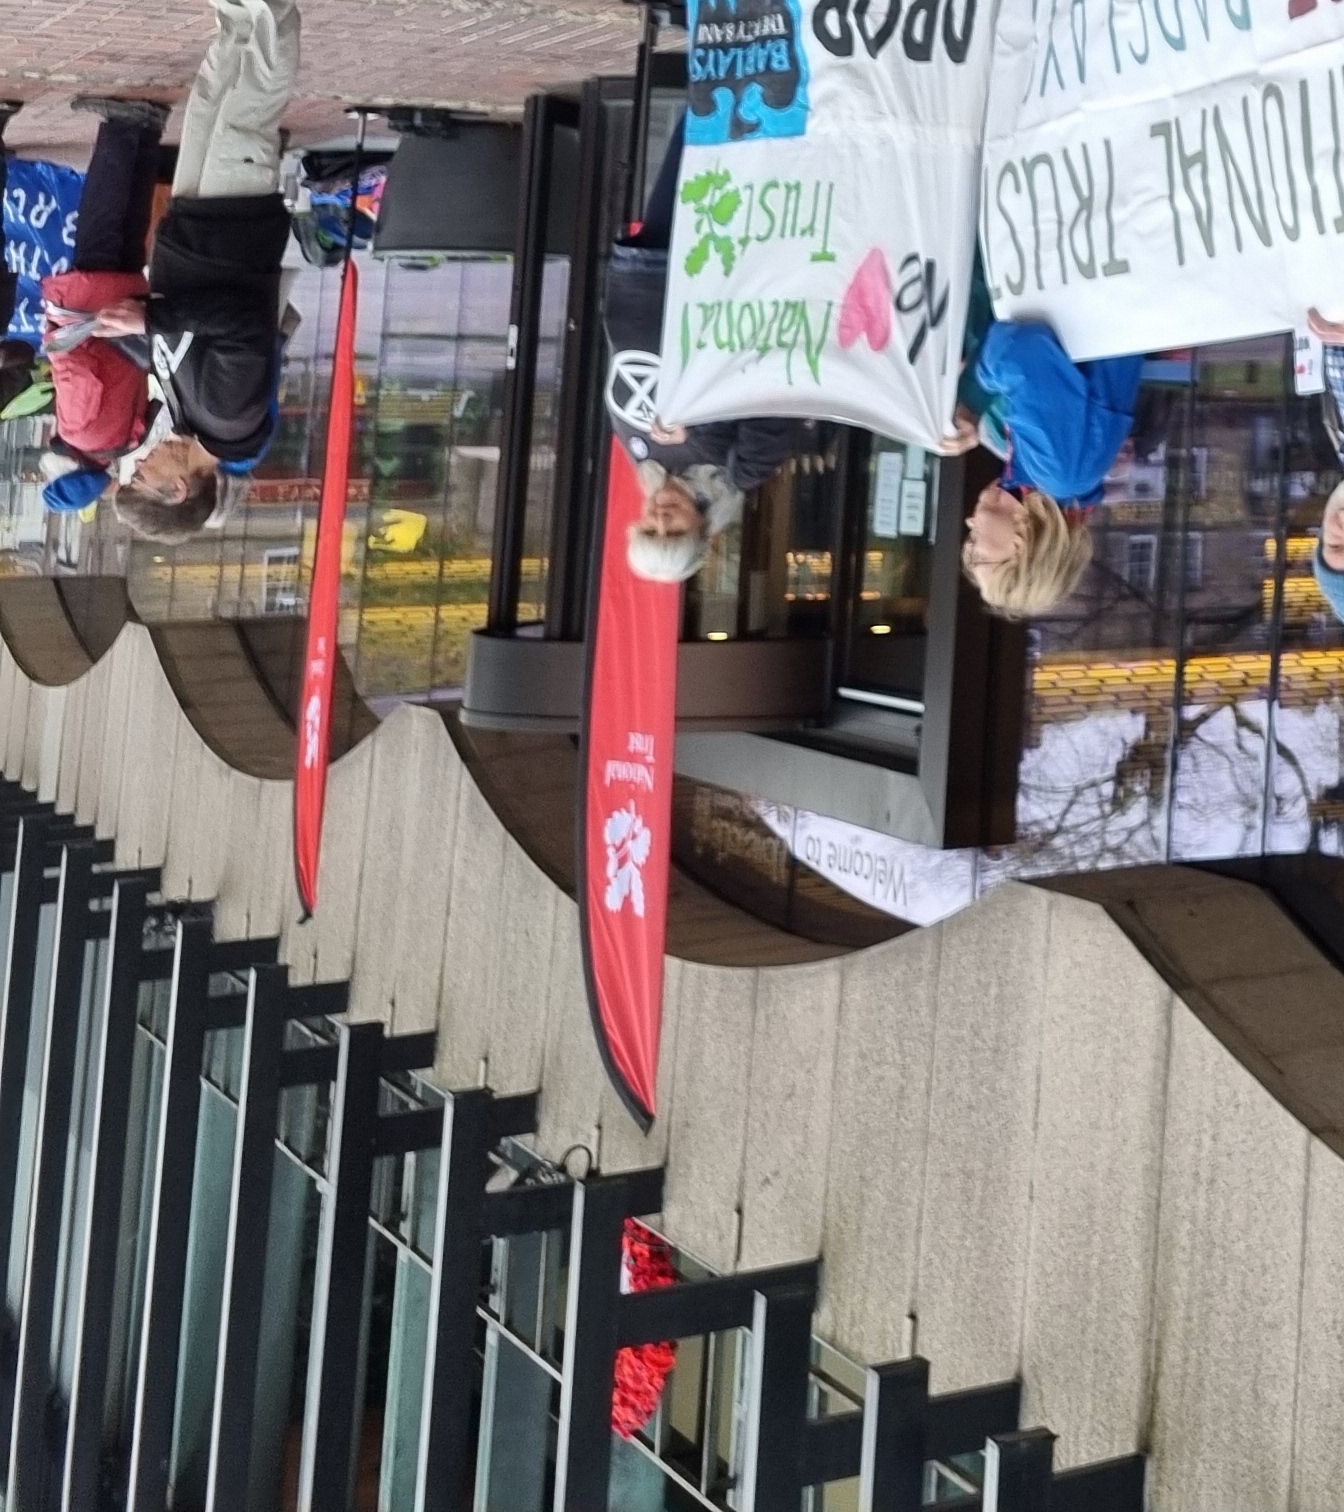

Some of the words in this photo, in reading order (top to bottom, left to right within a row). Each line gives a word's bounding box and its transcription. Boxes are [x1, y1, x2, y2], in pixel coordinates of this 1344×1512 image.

[737, 180, 837, 262] Trust
[982, 138, 1130, 301] TRUST
[681, 299, 834, 386] National
[805, 835, 822, 868] to
[827, 843, 908, 907] Welcome
